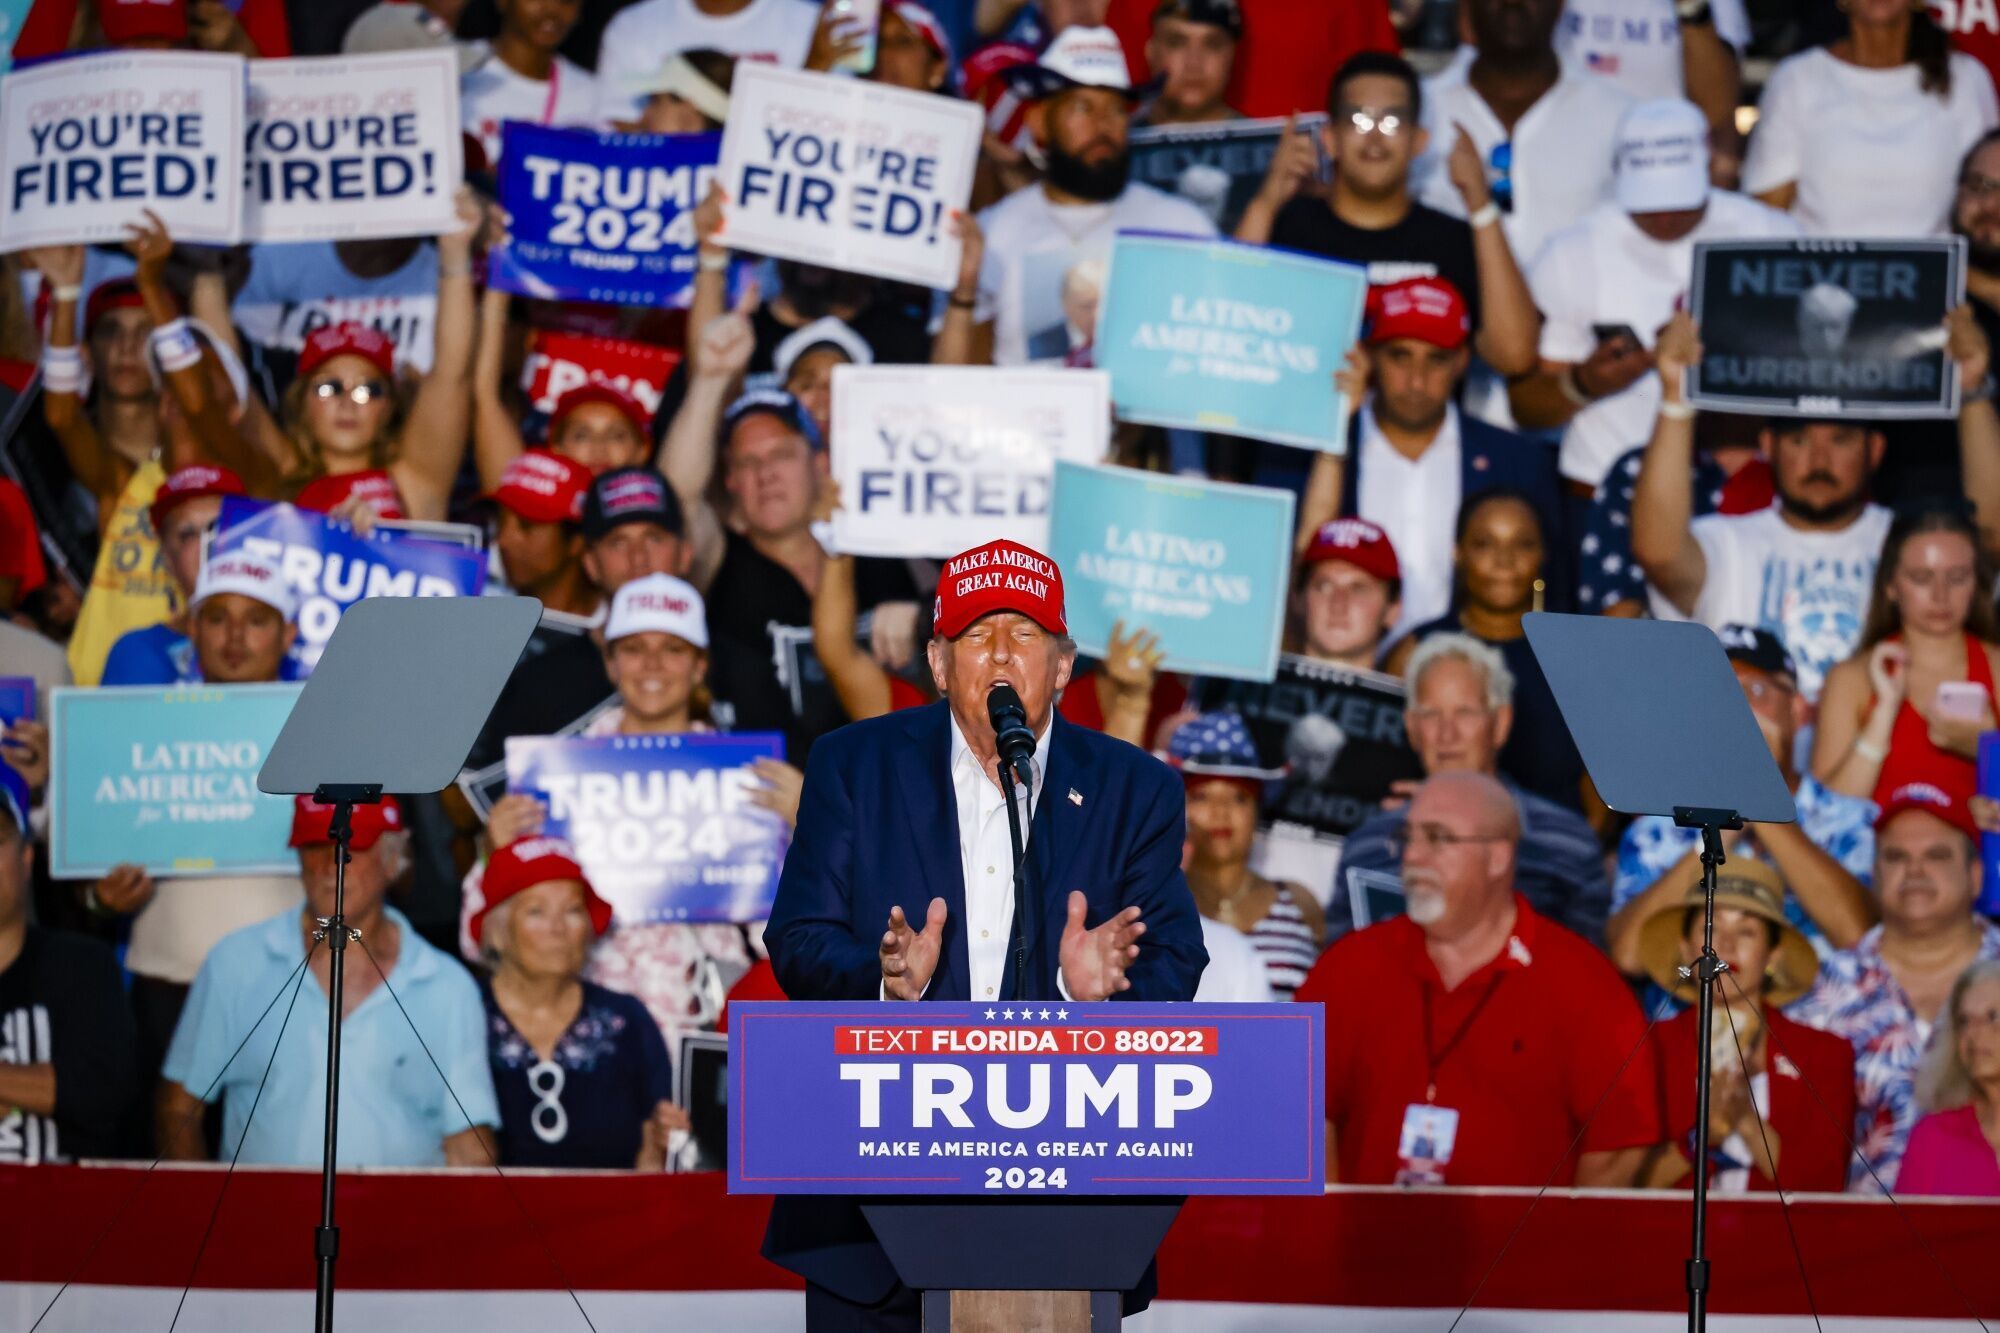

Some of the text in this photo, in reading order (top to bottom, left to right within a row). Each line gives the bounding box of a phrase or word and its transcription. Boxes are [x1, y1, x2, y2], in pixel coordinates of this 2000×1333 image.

[30, 113, 203, 157] YOU'RE
[12, 154, 217, 212] FIRED!
[738, 165, 943, 245] FIRED!
[549, 202, 697, 252] 2024
[1729, 259, 1919, 299] NEVER
[1170, 293, 1294, 336] LATINO
[1131, 322, 1319, 375] AMERICANS
[1706, 355, 1937, 391] SURRENDER
[949, 548, 1056, 582] MAKE AMERICA
[1105, 523, 1227, 570] LATINO
[956, 572, 1048, 602] GREAT AGAIN
[1075, 551, 1251, 605] AMERICANS
[131, 740, 261, 771] LATINO
[95, 773, 258, 804] AMERICA
[168, 803, 256, 824] TRUMP
[572, 816, 732, 865] 2024
[850, 1029, 1204, 1053] TEXT FLORIDA TO 88022
[840, 1063, 1213, 1129] TRUMP
[859, 1141, 1194, 1157] MAKE AMERICA GREAT AGAIN!
[984, 1167, 1068, 1189] 2024
